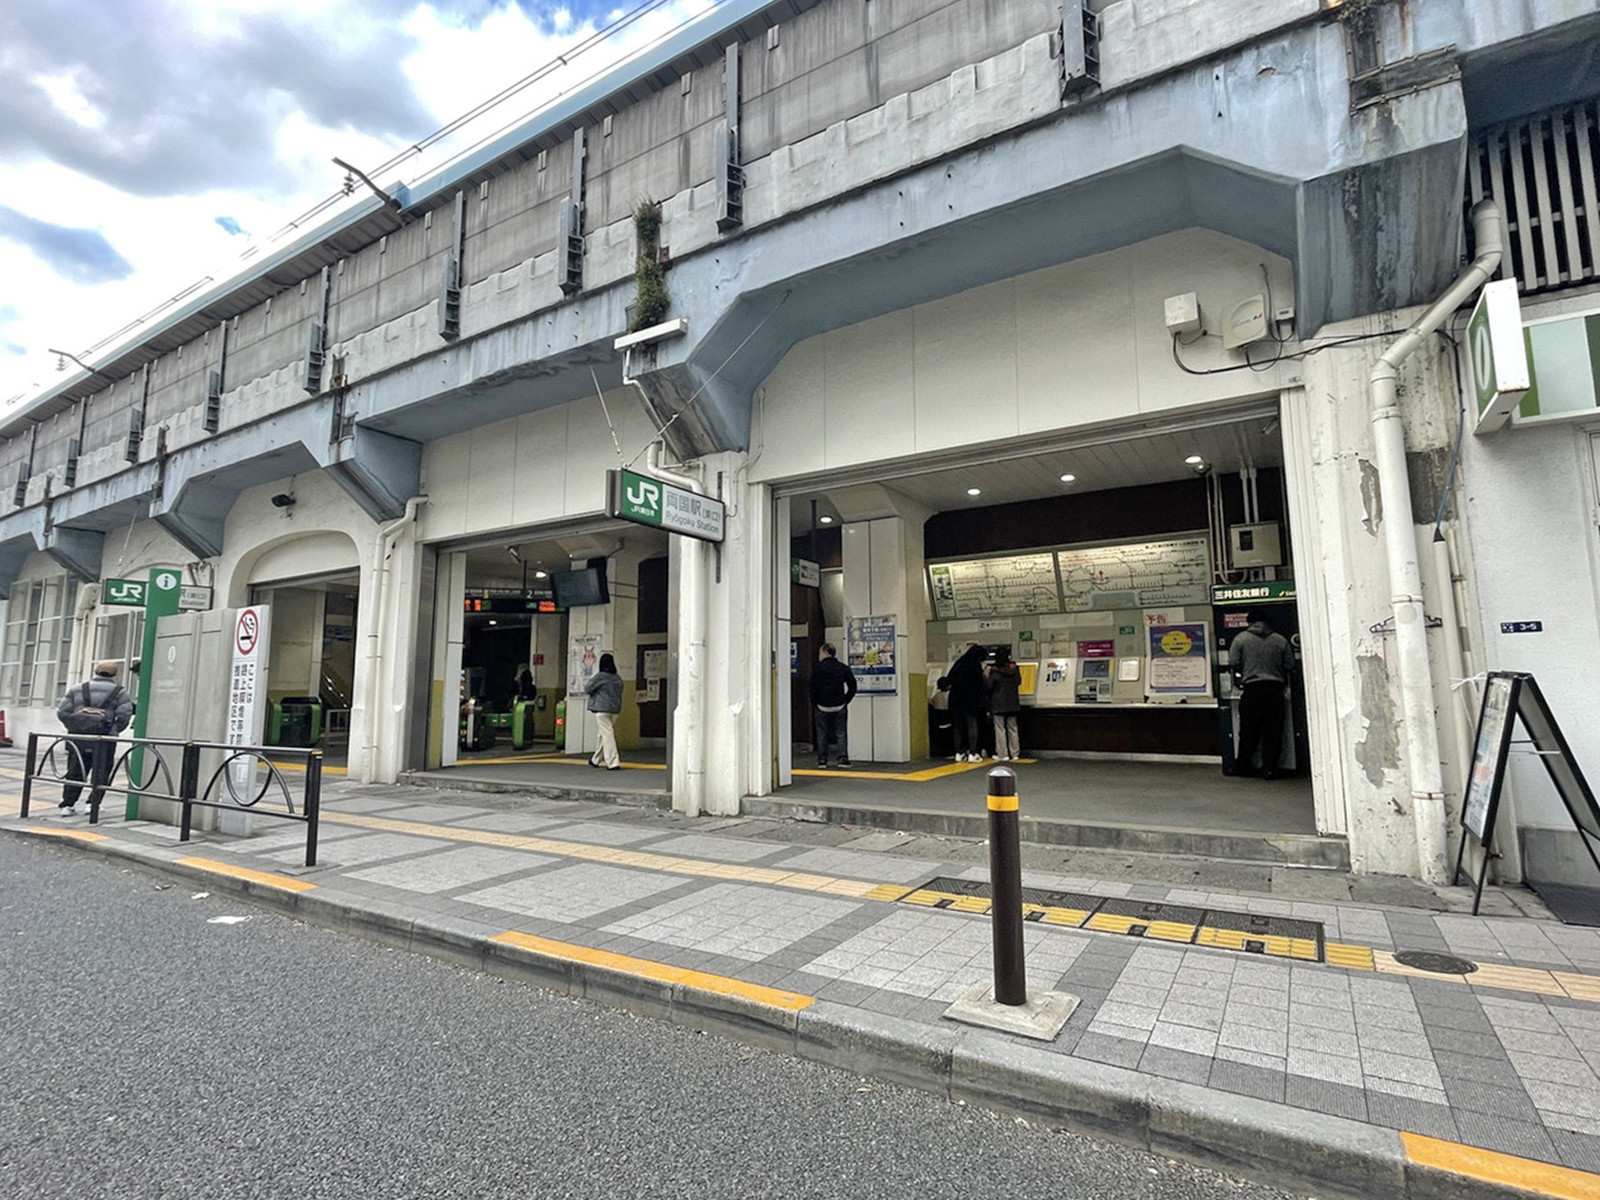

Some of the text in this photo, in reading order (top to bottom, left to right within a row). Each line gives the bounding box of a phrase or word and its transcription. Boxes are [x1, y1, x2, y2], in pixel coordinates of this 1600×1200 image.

[627, 481, 659, 510] JR
[696, 519, 719, 534] Station
[110, 583, 143, 598] JR
[1214, 586, 1270, 600] 三井住友銀行
